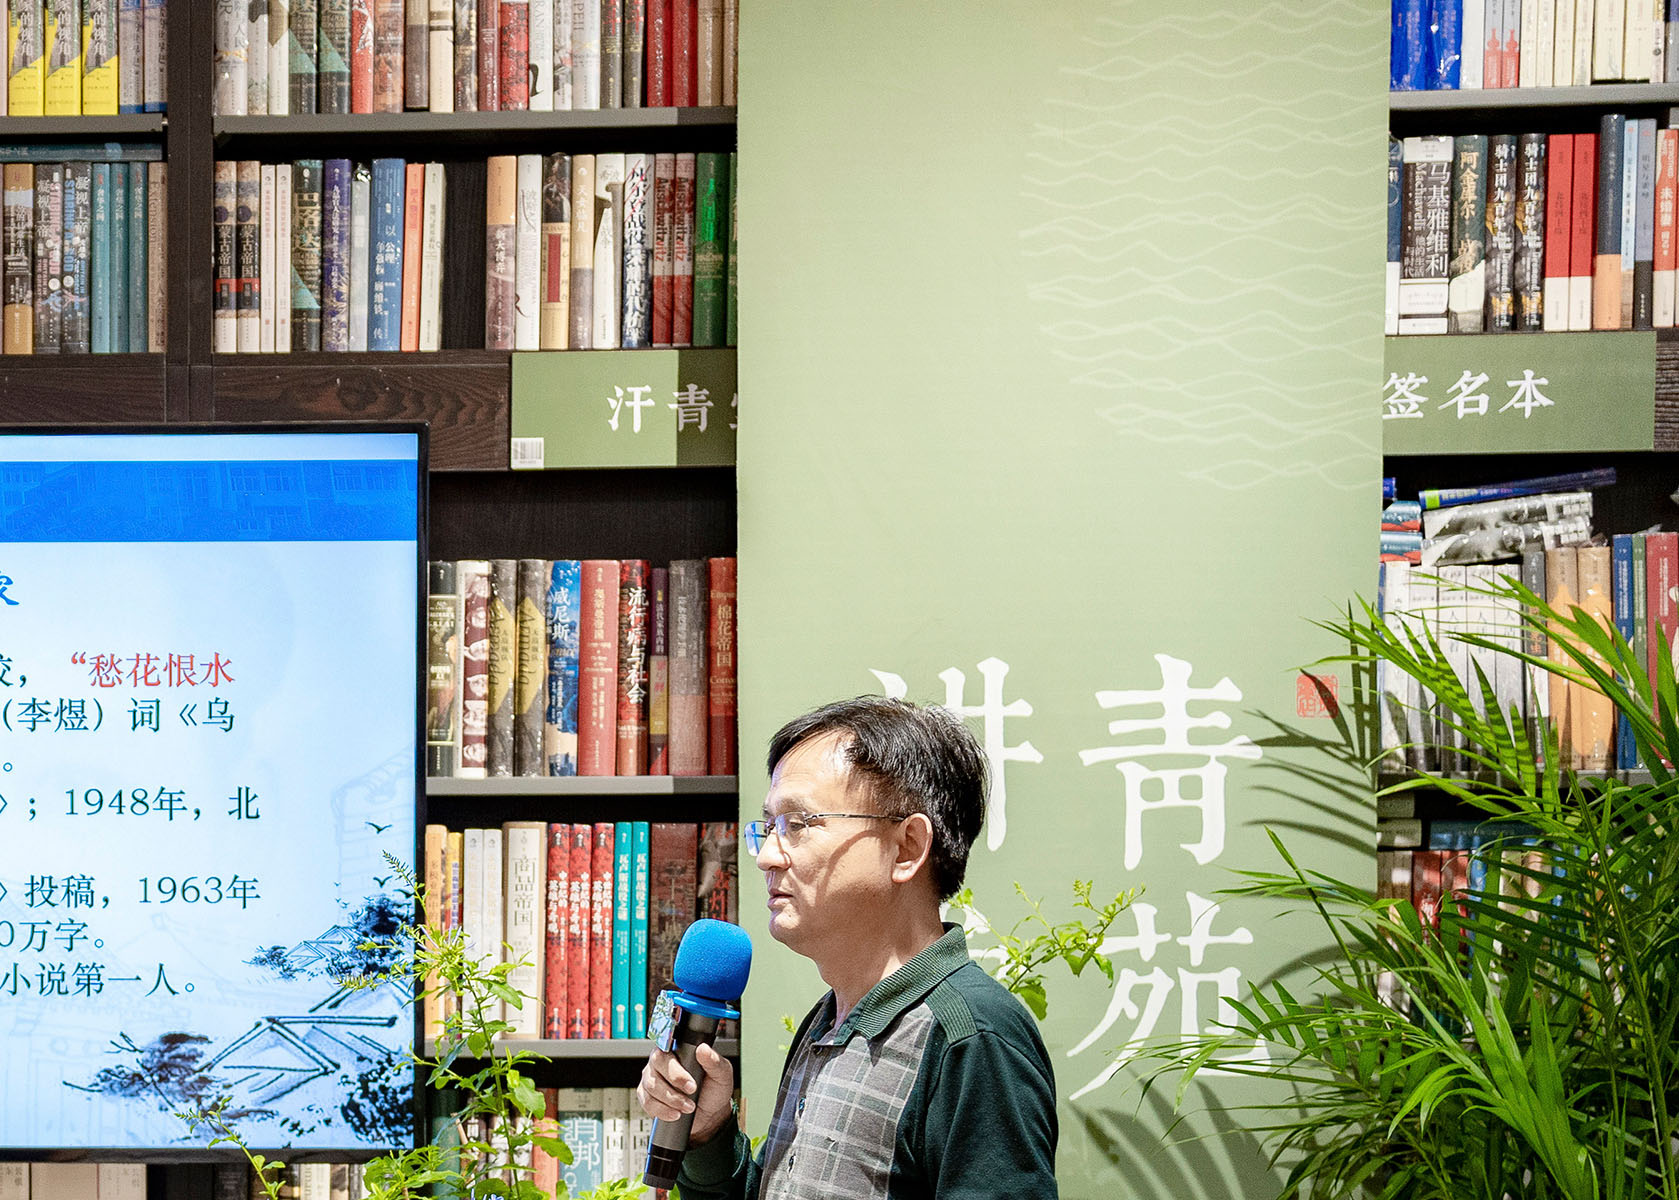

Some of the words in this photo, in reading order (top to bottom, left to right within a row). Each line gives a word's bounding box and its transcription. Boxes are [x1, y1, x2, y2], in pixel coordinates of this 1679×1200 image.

[1425, 162, 1451, 277] 马基雅维利
[219, 225, 232, 278] 蒙古帝国
[241, 225, 254, 278] 蒙古帝国
[607, 383, 737, 434] 汗青
[1382, 368, 1555, 420] 签名本
[552, 587, 571, 642] 威尼斯
[718, 604, 733, 668] 棉花帝国
[627, 587, 649, 704] 流行病与社会
[1067, 653, 1274, 1100] 青苑
[573, 1111, 600, 1171] 肖邦
